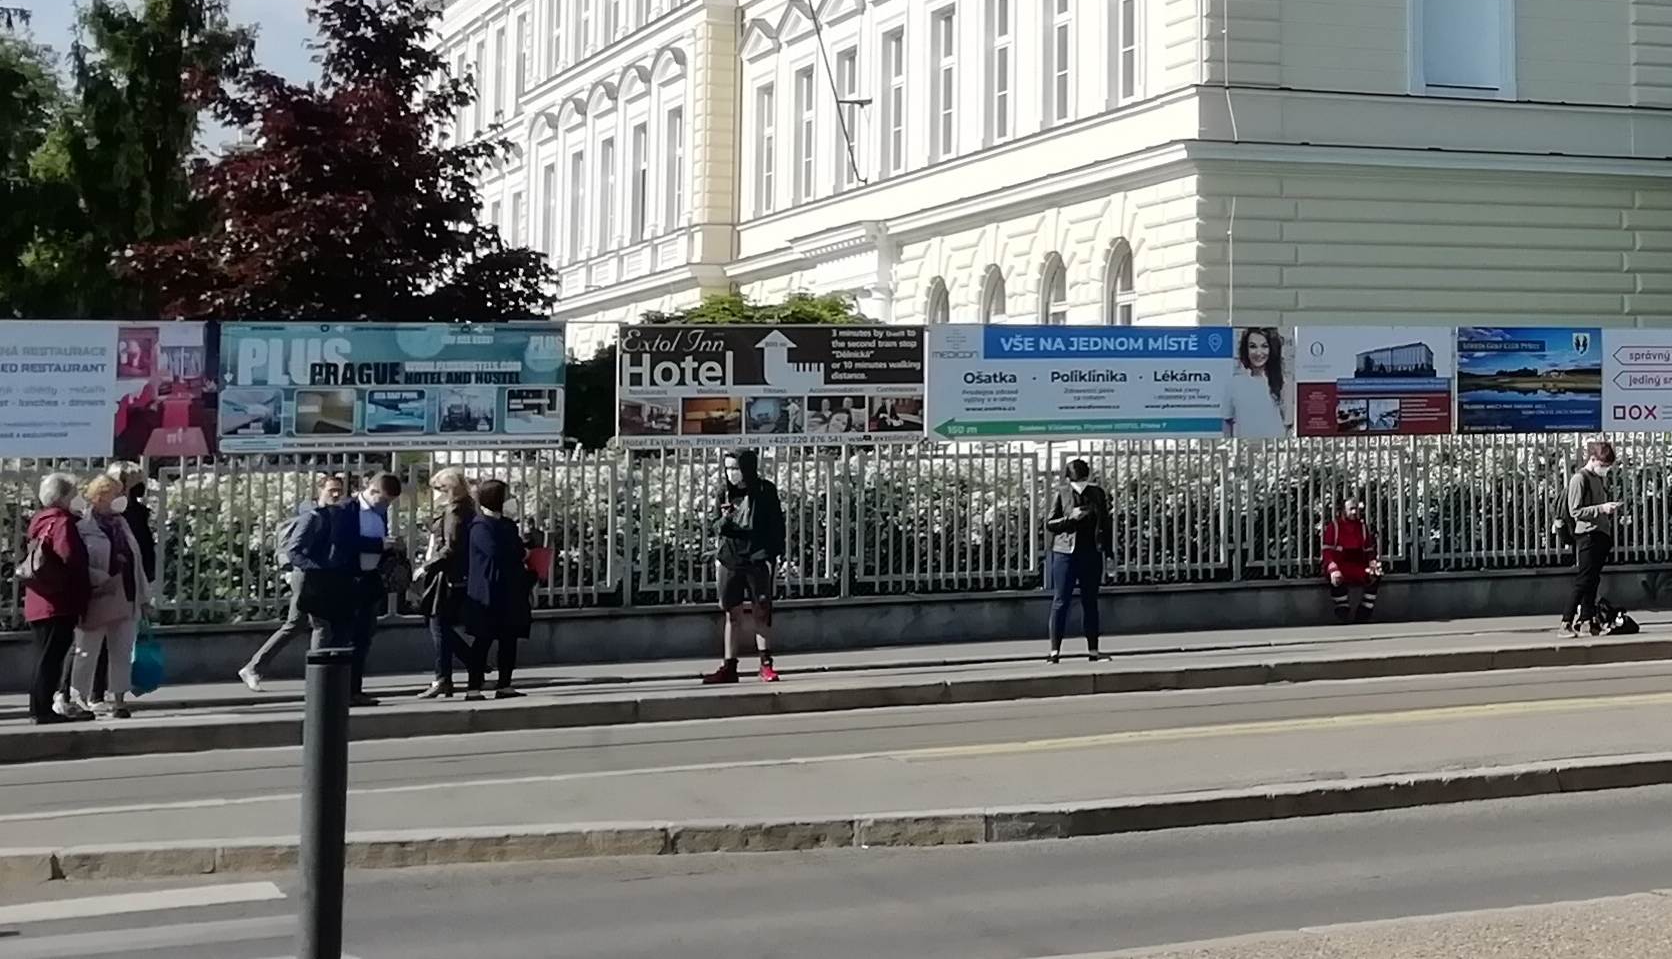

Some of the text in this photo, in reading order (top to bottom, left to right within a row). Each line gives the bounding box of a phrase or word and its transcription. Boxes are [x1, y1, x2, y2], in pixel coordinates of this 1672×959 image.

[873, 329, 884, 339] by
[906, 329, 916, 337] to
[621, 329, 725, 352] Extol Inn
[831, 340, 917, 349] the second tram stop
[1001, 334, 1199, 351] VŠE NA JEDNOM MÍSTĚ
[23, 346, 107, 356] RESTAURACE
[1629, 350, 1670, 361] správný
[238, 338, 351, 385] PLUS
[843, 361, 853, 369] 10
[854, 361, 887, 369] minutes
[888, 360, 921, 370] walking
[22, 363, 107, 373] RESTAURANT
[622, 351, 733, 387] Hotel
[310, 363, 400, 385] PRAGUE
[404, 372, 520, 384] HOTEL AND HOSTEL
[831, 371, 868, 380] distance.
[963, 370, 1017, 384] Ošatka
[1050, 369, 1127, 383] Poliklinika
[1153, 369, 1211, 382] Lékárna
[1629, 375, 1660, 386] jediný
[947, 425, 964, 434] 150
[622, 439, 646, 447] Hotel
[650, 438, 673, 446] Extol
